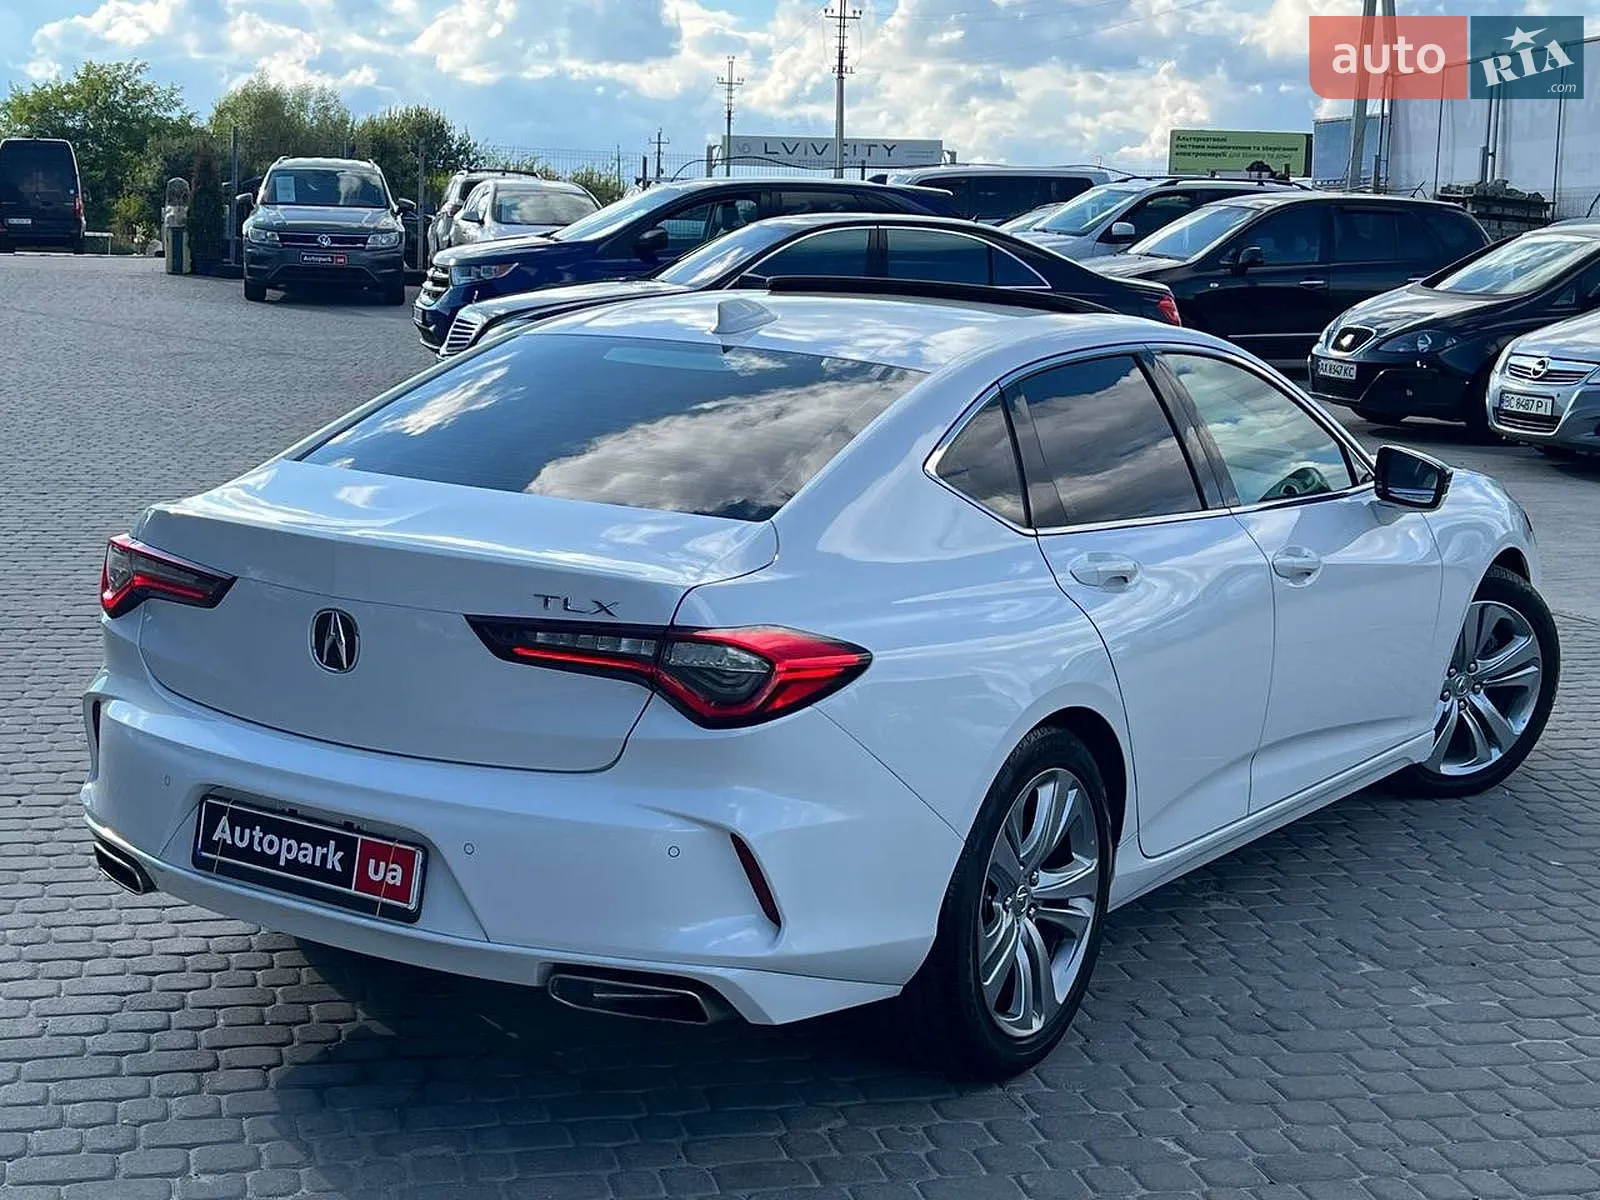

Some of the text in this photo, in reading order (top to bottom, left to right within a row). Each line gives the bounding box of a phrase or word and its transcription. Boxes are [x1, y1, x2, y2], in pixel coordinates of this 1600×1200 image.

[763, 142, 829, 156] LVIV
[533, 593, 620, 617] TLX
[212, 815, 402, 886] Autopark ua
